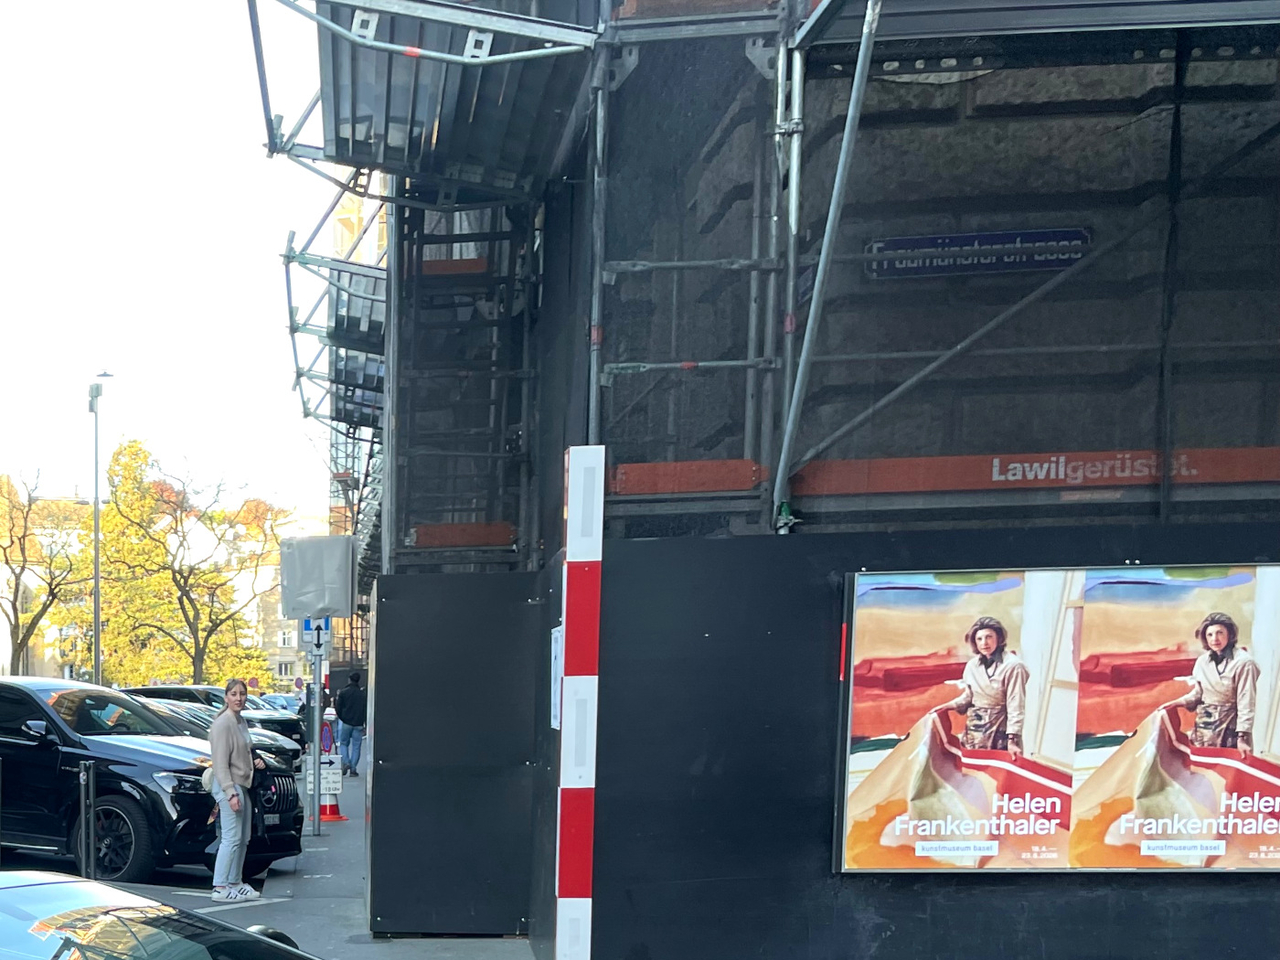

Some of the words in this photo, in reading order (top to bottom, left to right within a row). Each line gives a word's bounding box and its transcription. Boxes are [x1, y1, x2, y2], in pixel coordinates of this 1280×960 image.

[992, 792, 1062, 814] Helen
[894, 814, 1061, 836] Frankenthaler
[1120, 813, 1280, 835] Frankenthale
[921, 844, 971, 852] kunstmuseum
[973, 844, 993, 852] basel
[1147, 843, 1198, 852] kunstmuseum
[1200, 843, 1220, 852] basel
